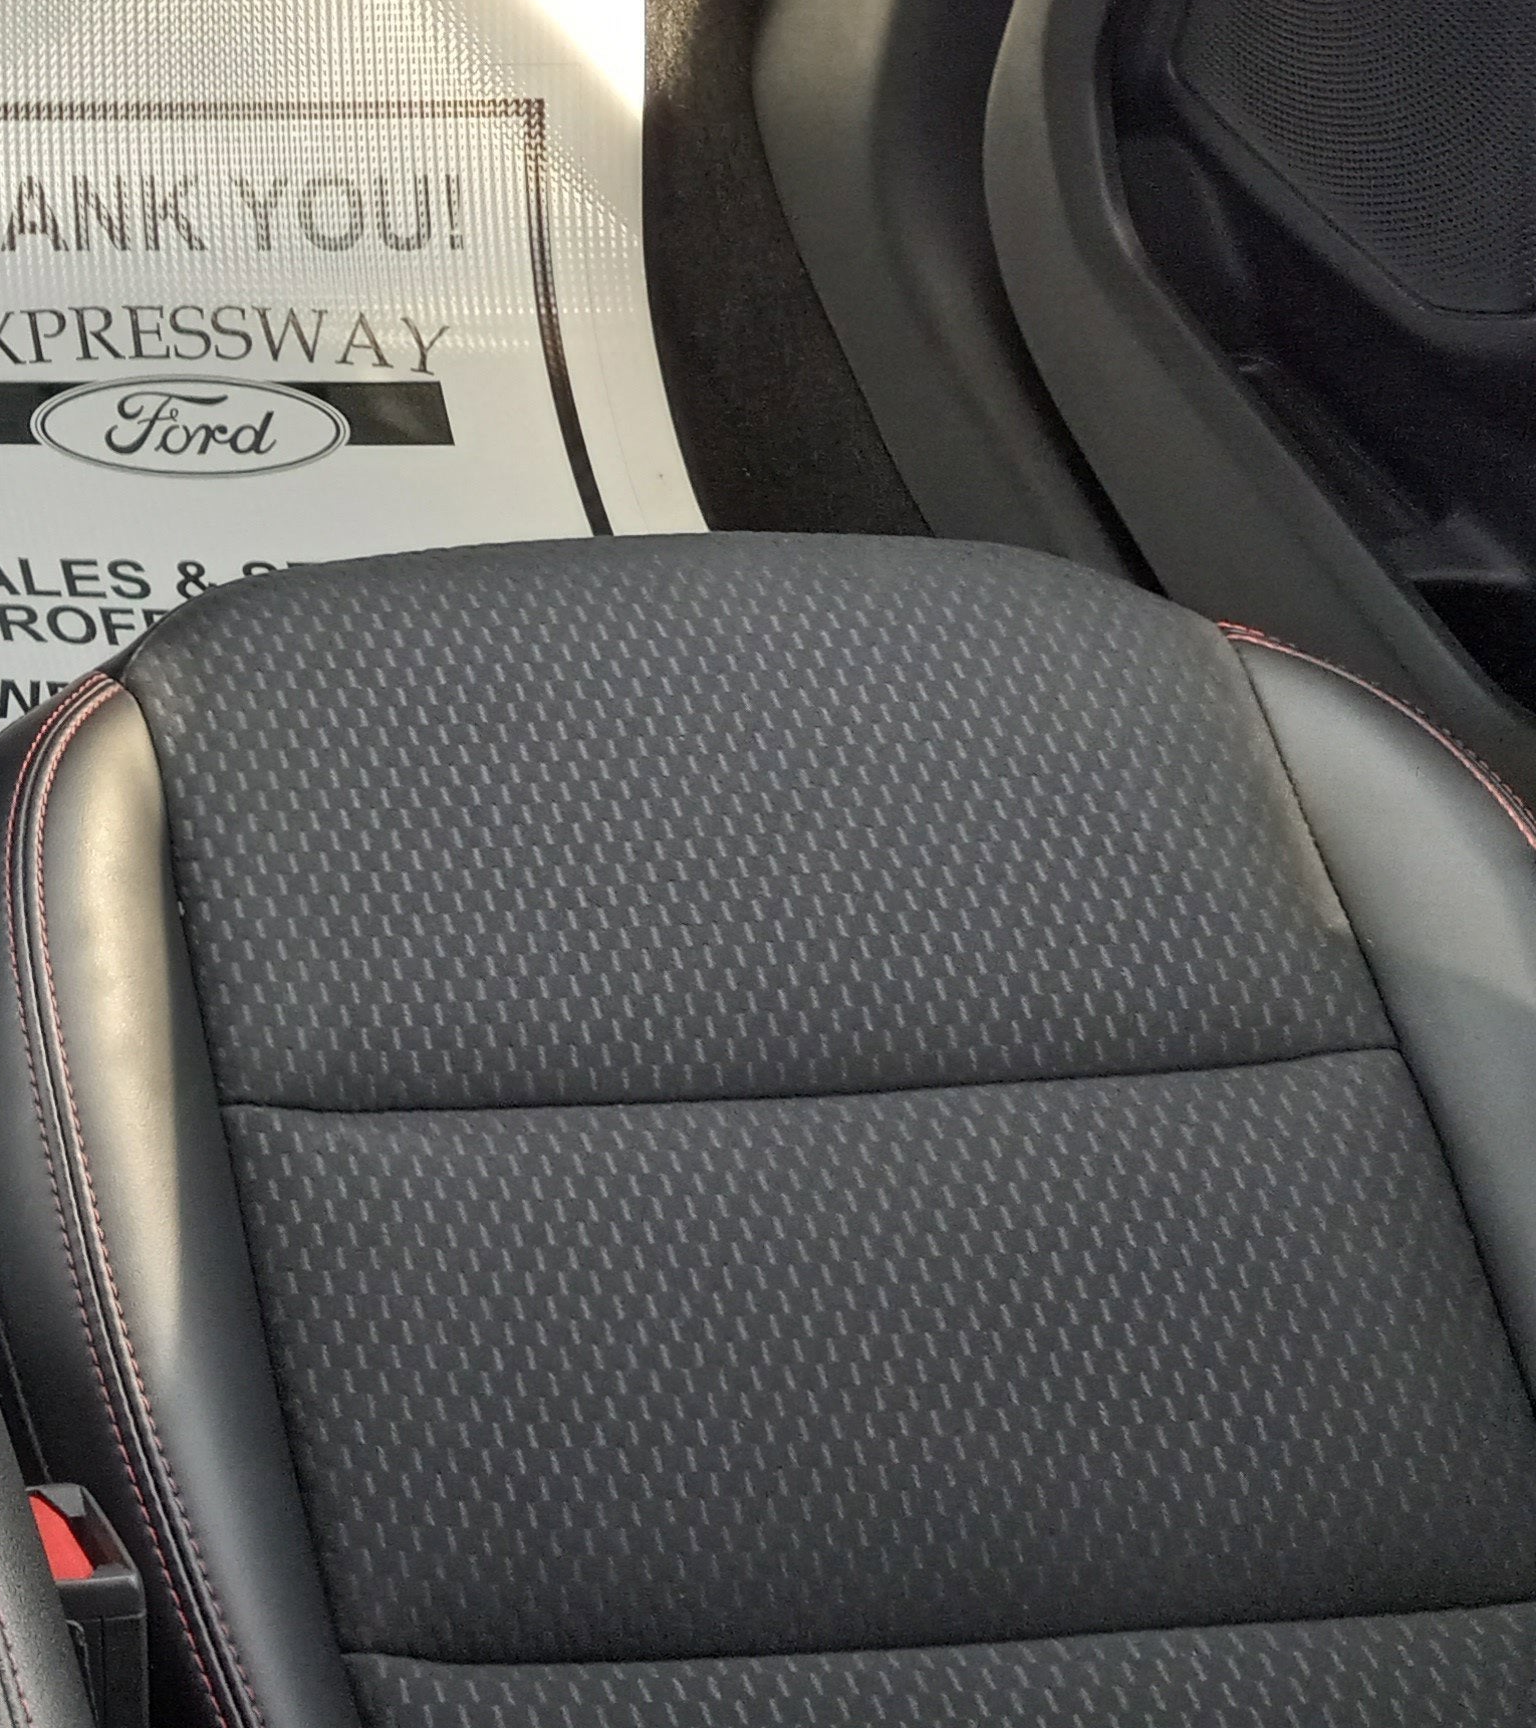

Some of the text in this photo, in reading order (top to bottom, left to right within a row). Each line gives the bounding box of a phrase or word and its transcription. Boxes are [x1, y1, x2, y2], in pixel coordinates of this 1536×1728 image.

[230, 172, 465, 252] YOU!
[104, 391, 278, 458] Ford
[176, 559, 219, 599] &
